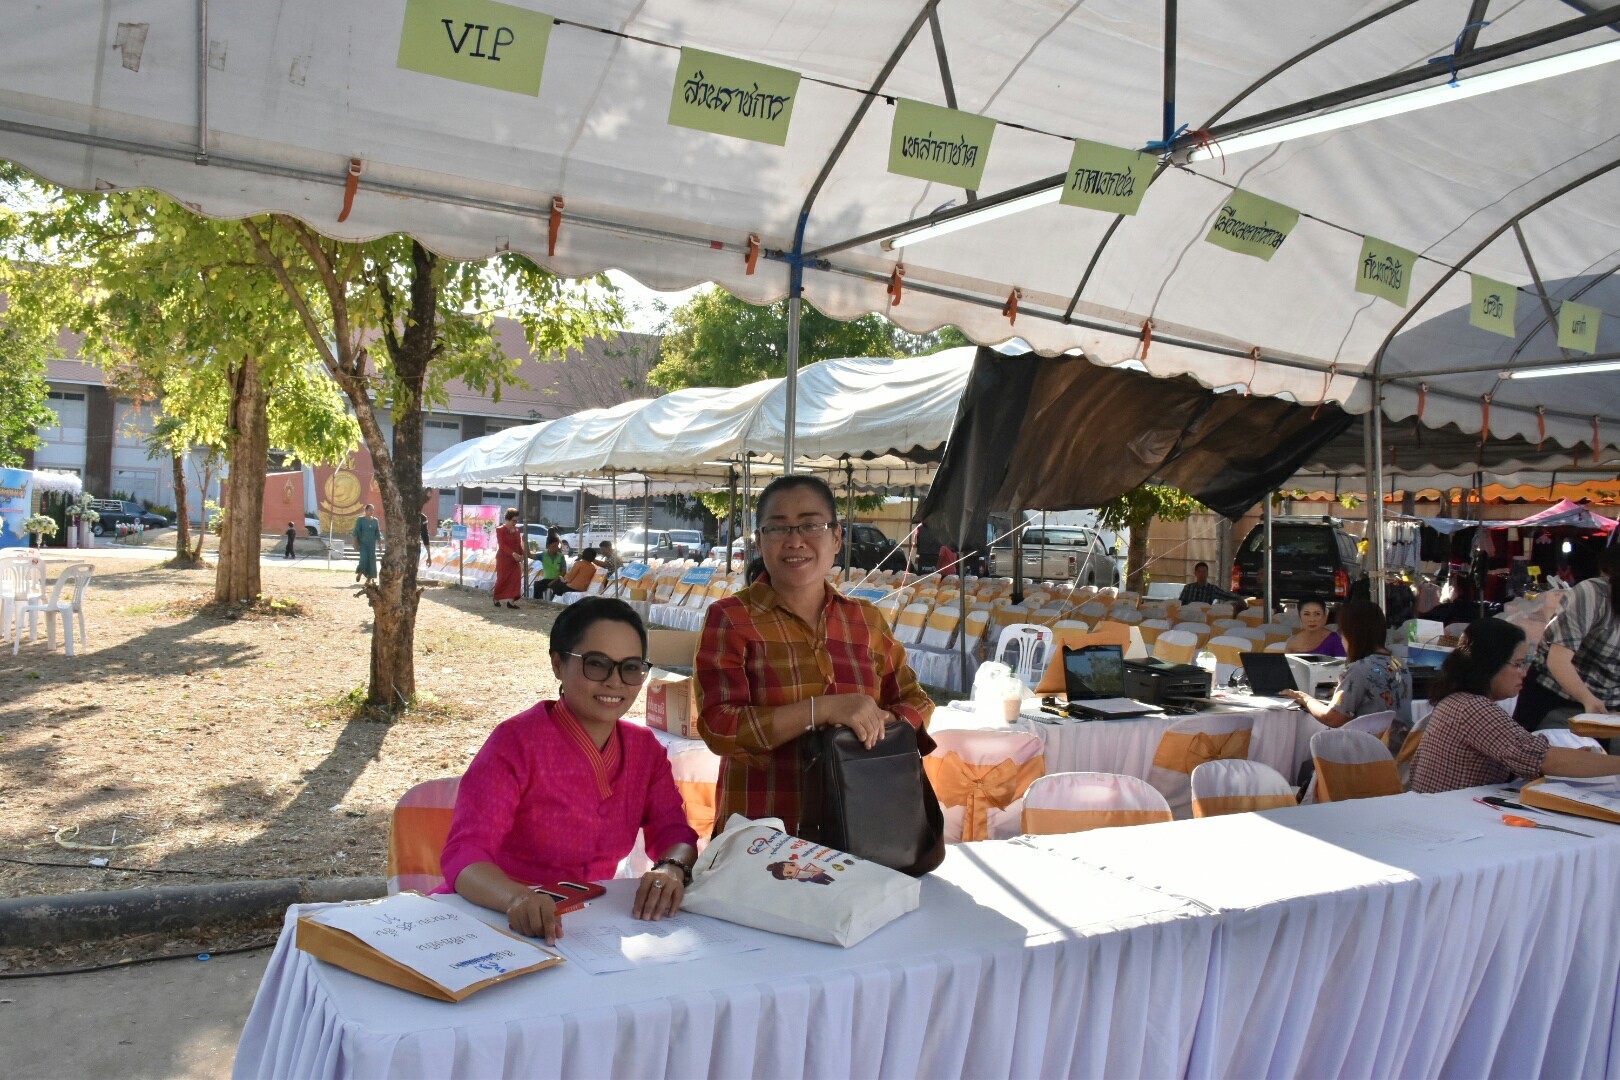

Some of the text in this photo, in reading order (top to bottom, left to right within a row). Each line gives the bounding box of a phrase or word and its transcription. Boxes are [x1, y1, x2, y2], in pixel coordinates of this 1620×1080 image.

[441, 19, 514, 62] VIP
[684, 70, 791, 121] ส่วนราชการ
[902, 131, 978, 168] เหล่ากาชาด
[1071, 166, 1136, 197] ภาคเอกชน
